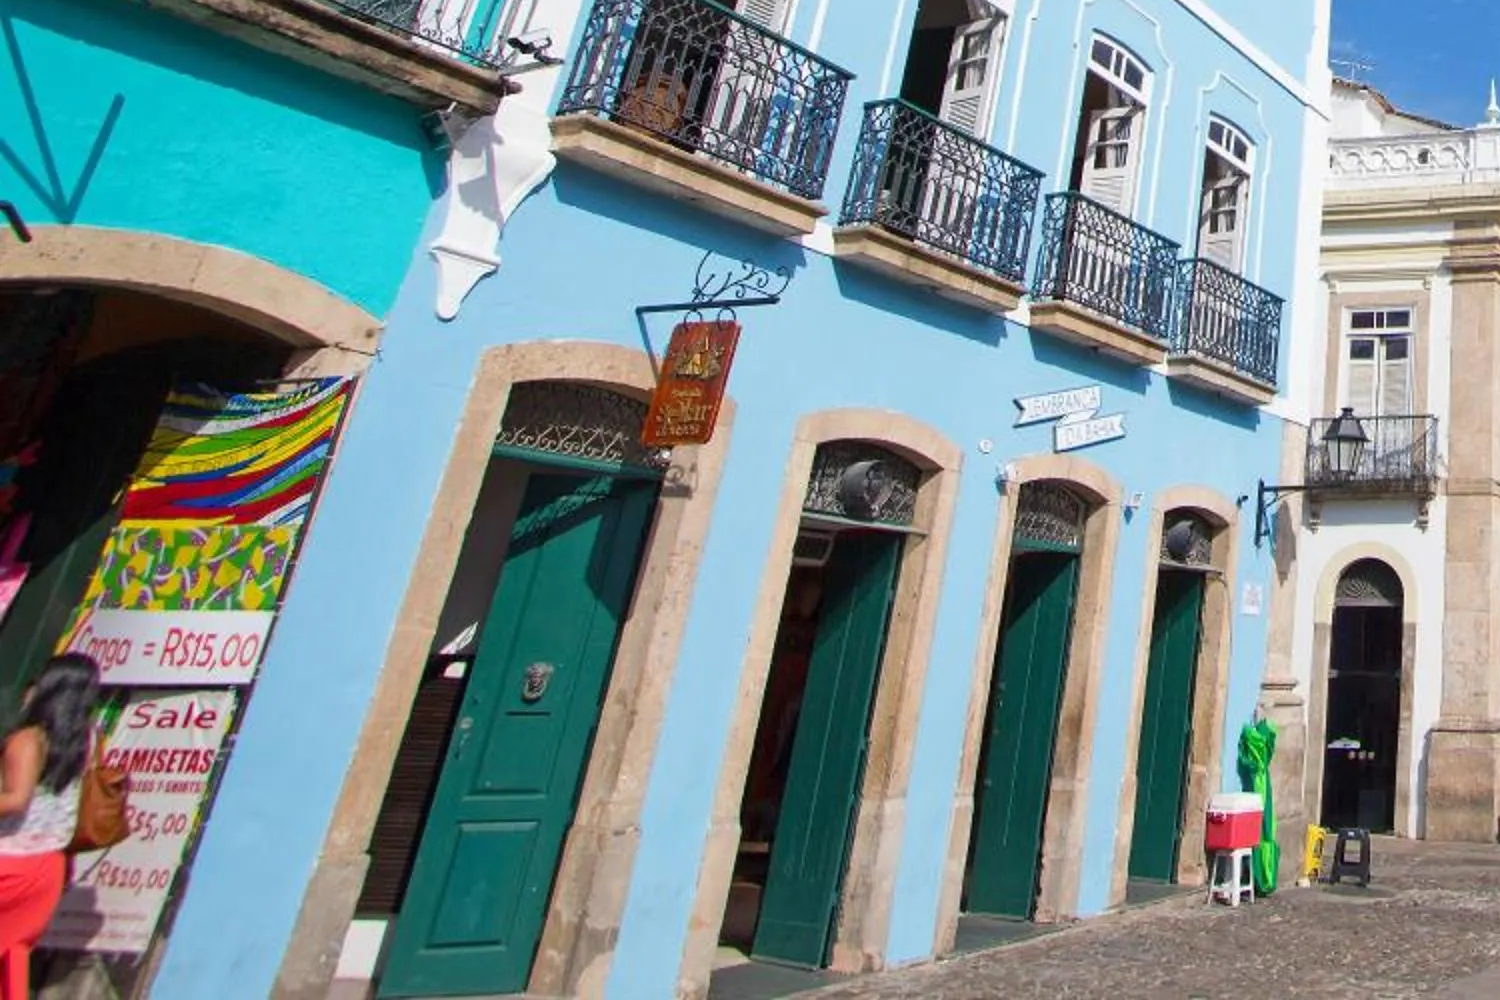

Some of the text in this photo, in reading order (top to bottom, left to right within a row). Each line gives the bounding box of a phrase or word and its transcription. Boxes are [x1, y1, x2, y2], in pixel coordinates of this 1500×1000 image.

[160, 627, 259, 672] R$15,00
[128, 701, 217, 730] Sale
[103, 748, 215, 775] CAMISETAS
